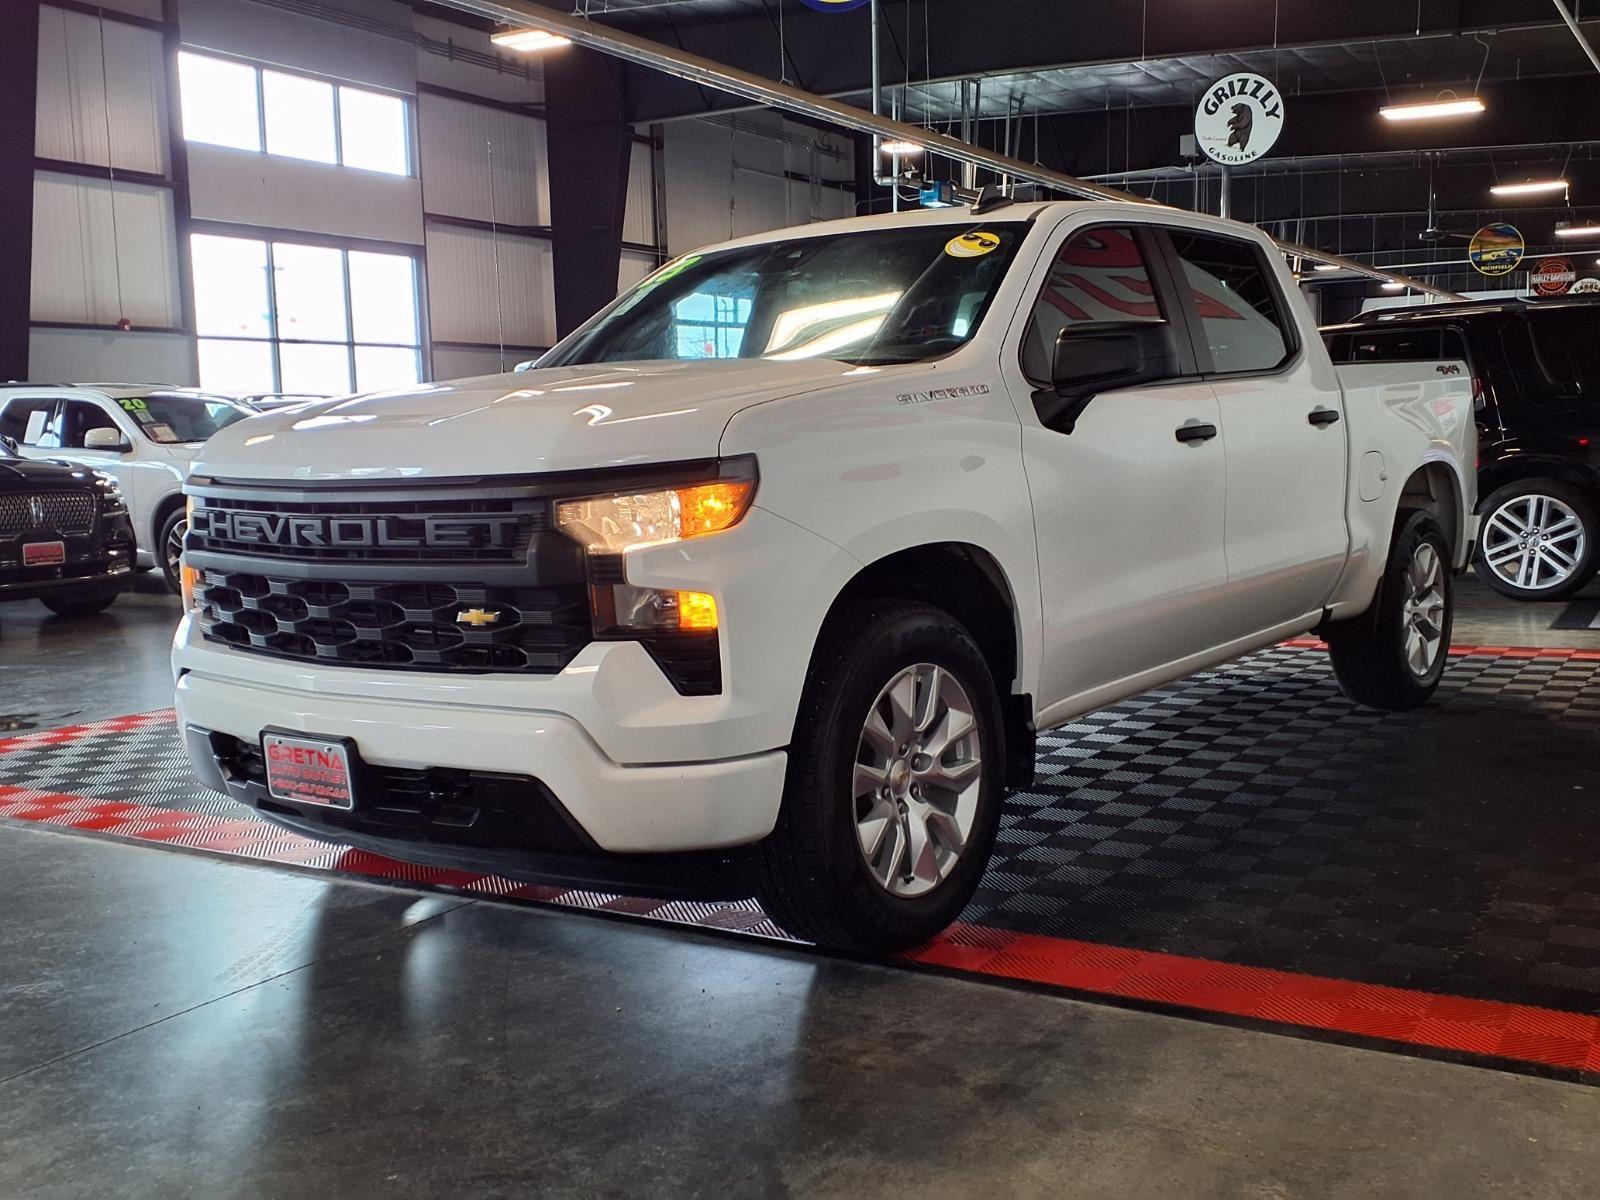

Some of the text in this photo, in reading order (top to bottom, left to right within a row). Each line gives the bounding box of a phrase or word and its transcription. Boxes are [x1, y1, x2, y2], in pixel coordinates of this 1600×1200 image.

[1204, 78, 1280, 119] GRIZZLY
[1208, 147, 1258, 162] GASOLINE
[119, 398, 147, 410] 20
[896, 384, 990, 405] SILVERADO
[189, 510, 519, 547] CHEVROLET
[268, 744, 345, 771] GRETNA
